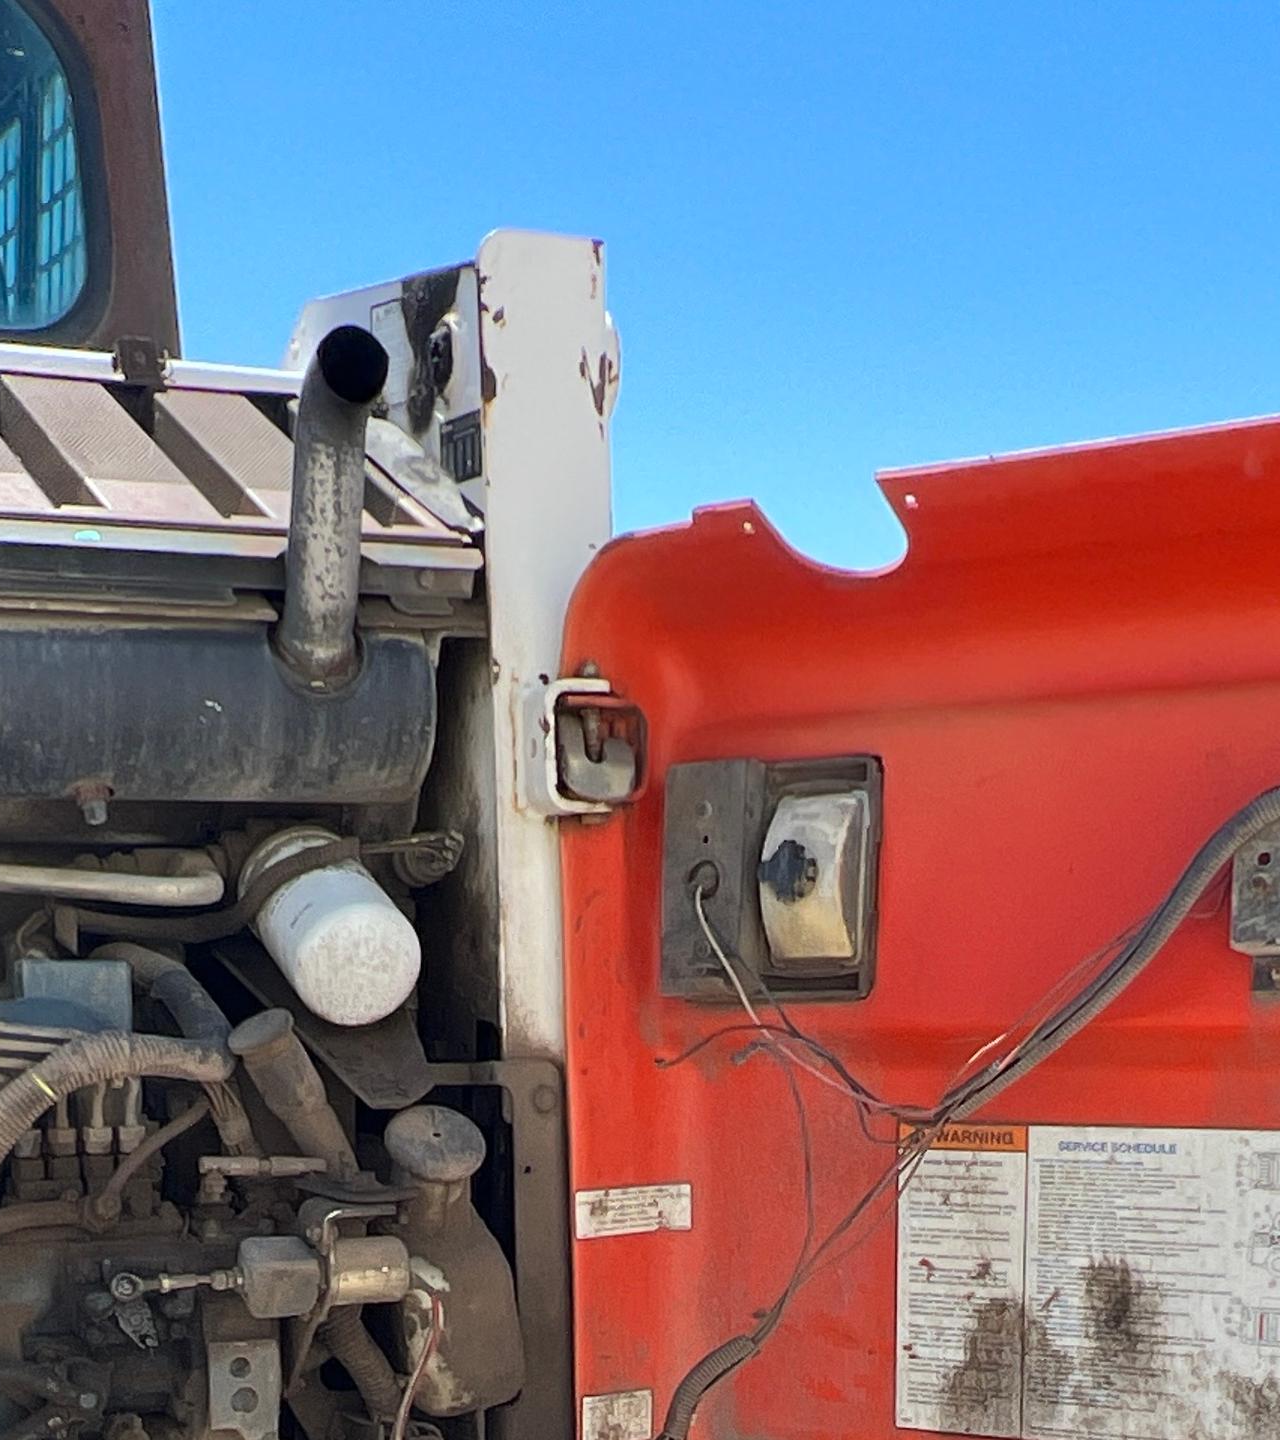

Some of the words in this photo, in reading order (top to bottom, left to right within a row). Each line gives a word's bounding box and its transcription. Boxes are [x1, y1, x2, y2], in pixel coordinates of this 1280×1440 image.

[935, 1129, 1014, 1145] WARNING
[1058, 1140, 1109, 1152] SERVICE
[1111, 1142, 1178, 1155] SCHEDULE
